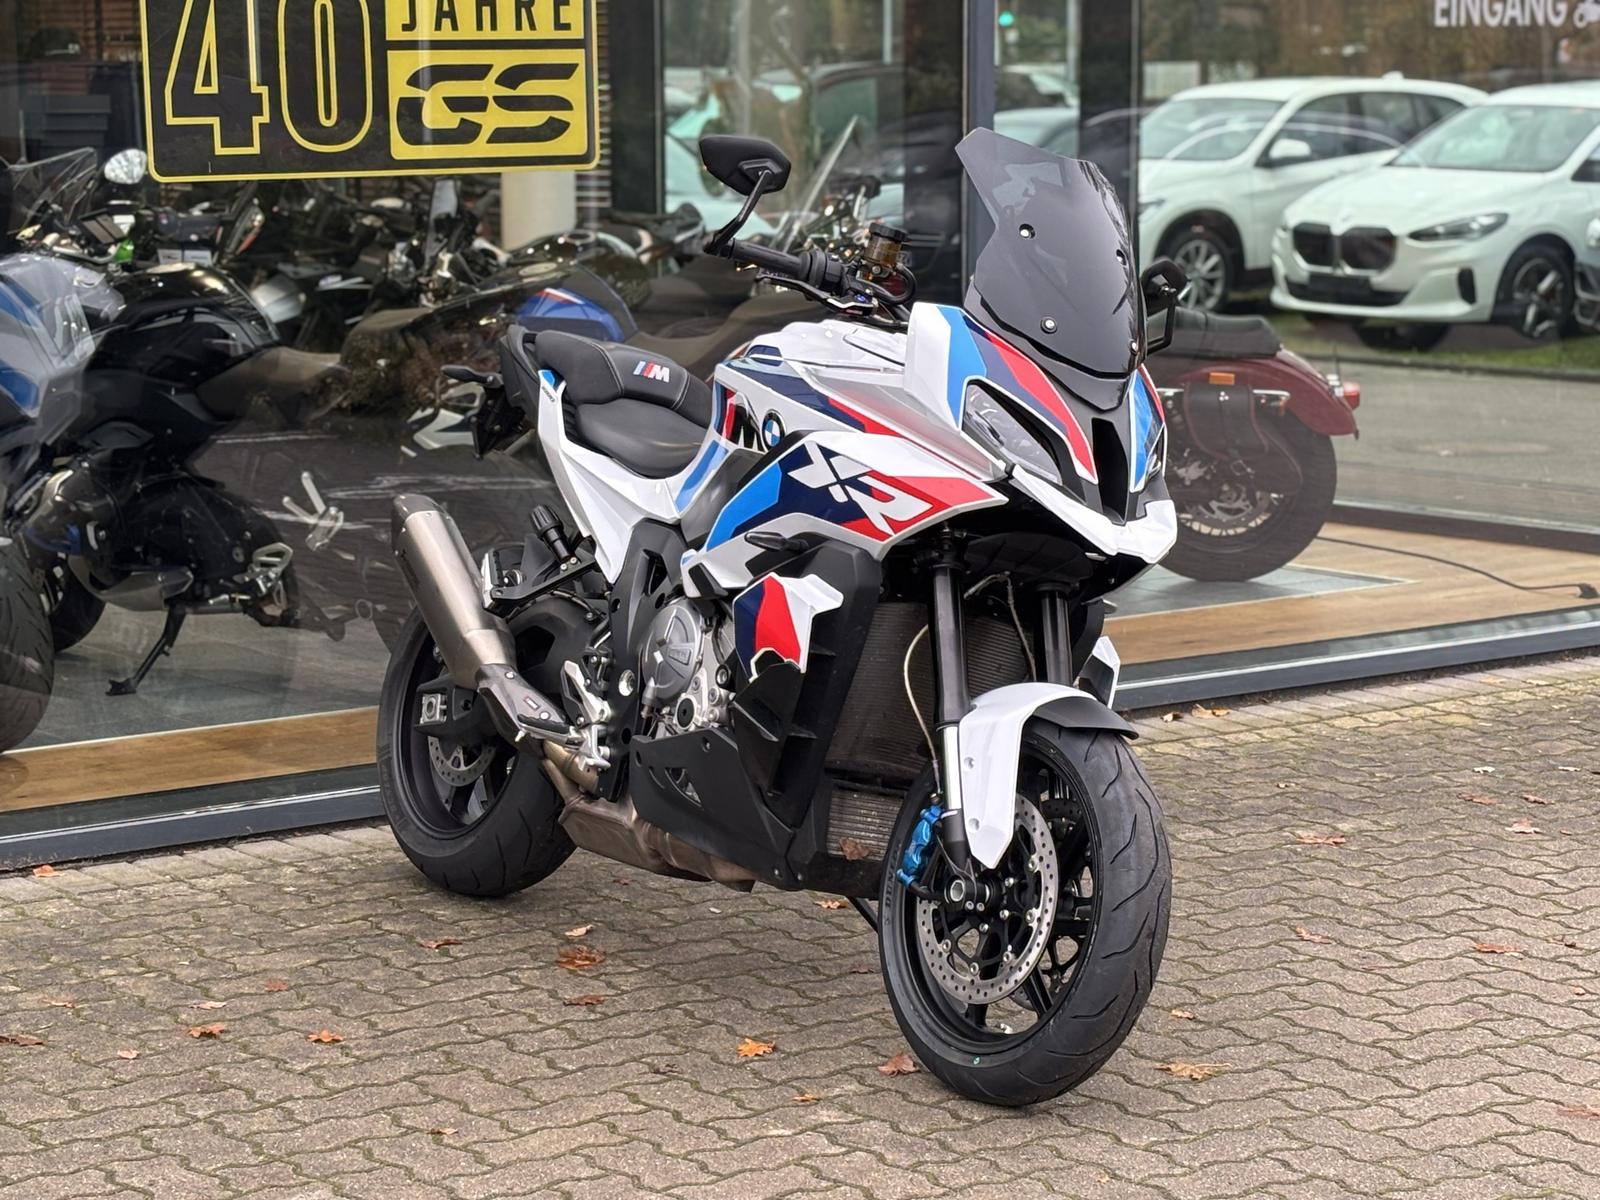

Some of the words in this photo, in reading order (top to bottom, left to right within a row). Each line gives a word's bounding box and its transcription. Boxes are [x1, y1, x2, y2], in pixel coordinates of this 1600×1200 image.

[401, 0, 572, 32] JAHRE
[1434, 0, 1568, 28] EINGANG
[164, 0, 373, 156] 40
[396, 63, 579, 146] GS
[787, 440, 934, 537] XR
